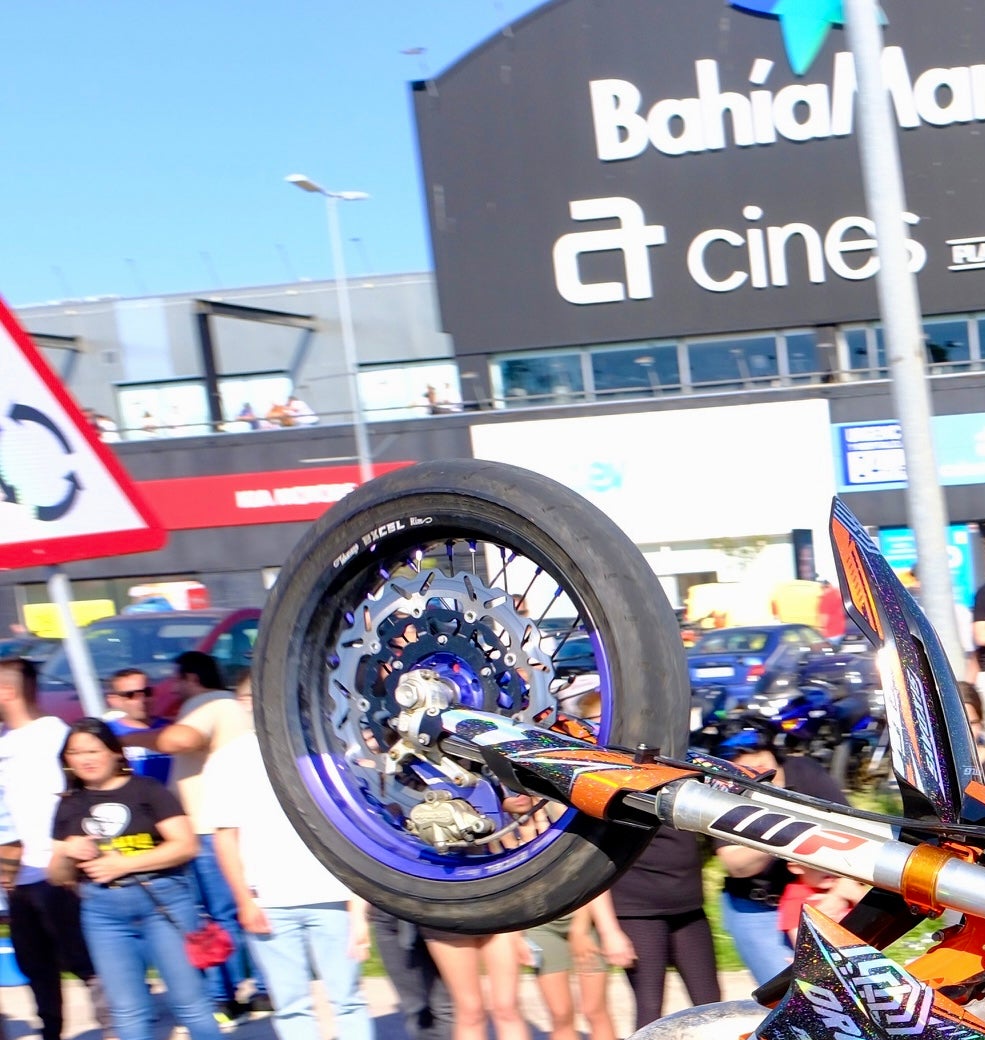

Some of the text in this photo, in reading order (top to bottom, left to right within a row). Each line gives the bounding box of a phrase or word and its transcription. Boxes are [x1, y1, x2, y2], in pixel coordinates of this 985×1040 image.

[687, 205, 927, 291] cines
[361, 520, 406, 546] EXCEL
[709, 804, 869, 856] WP
